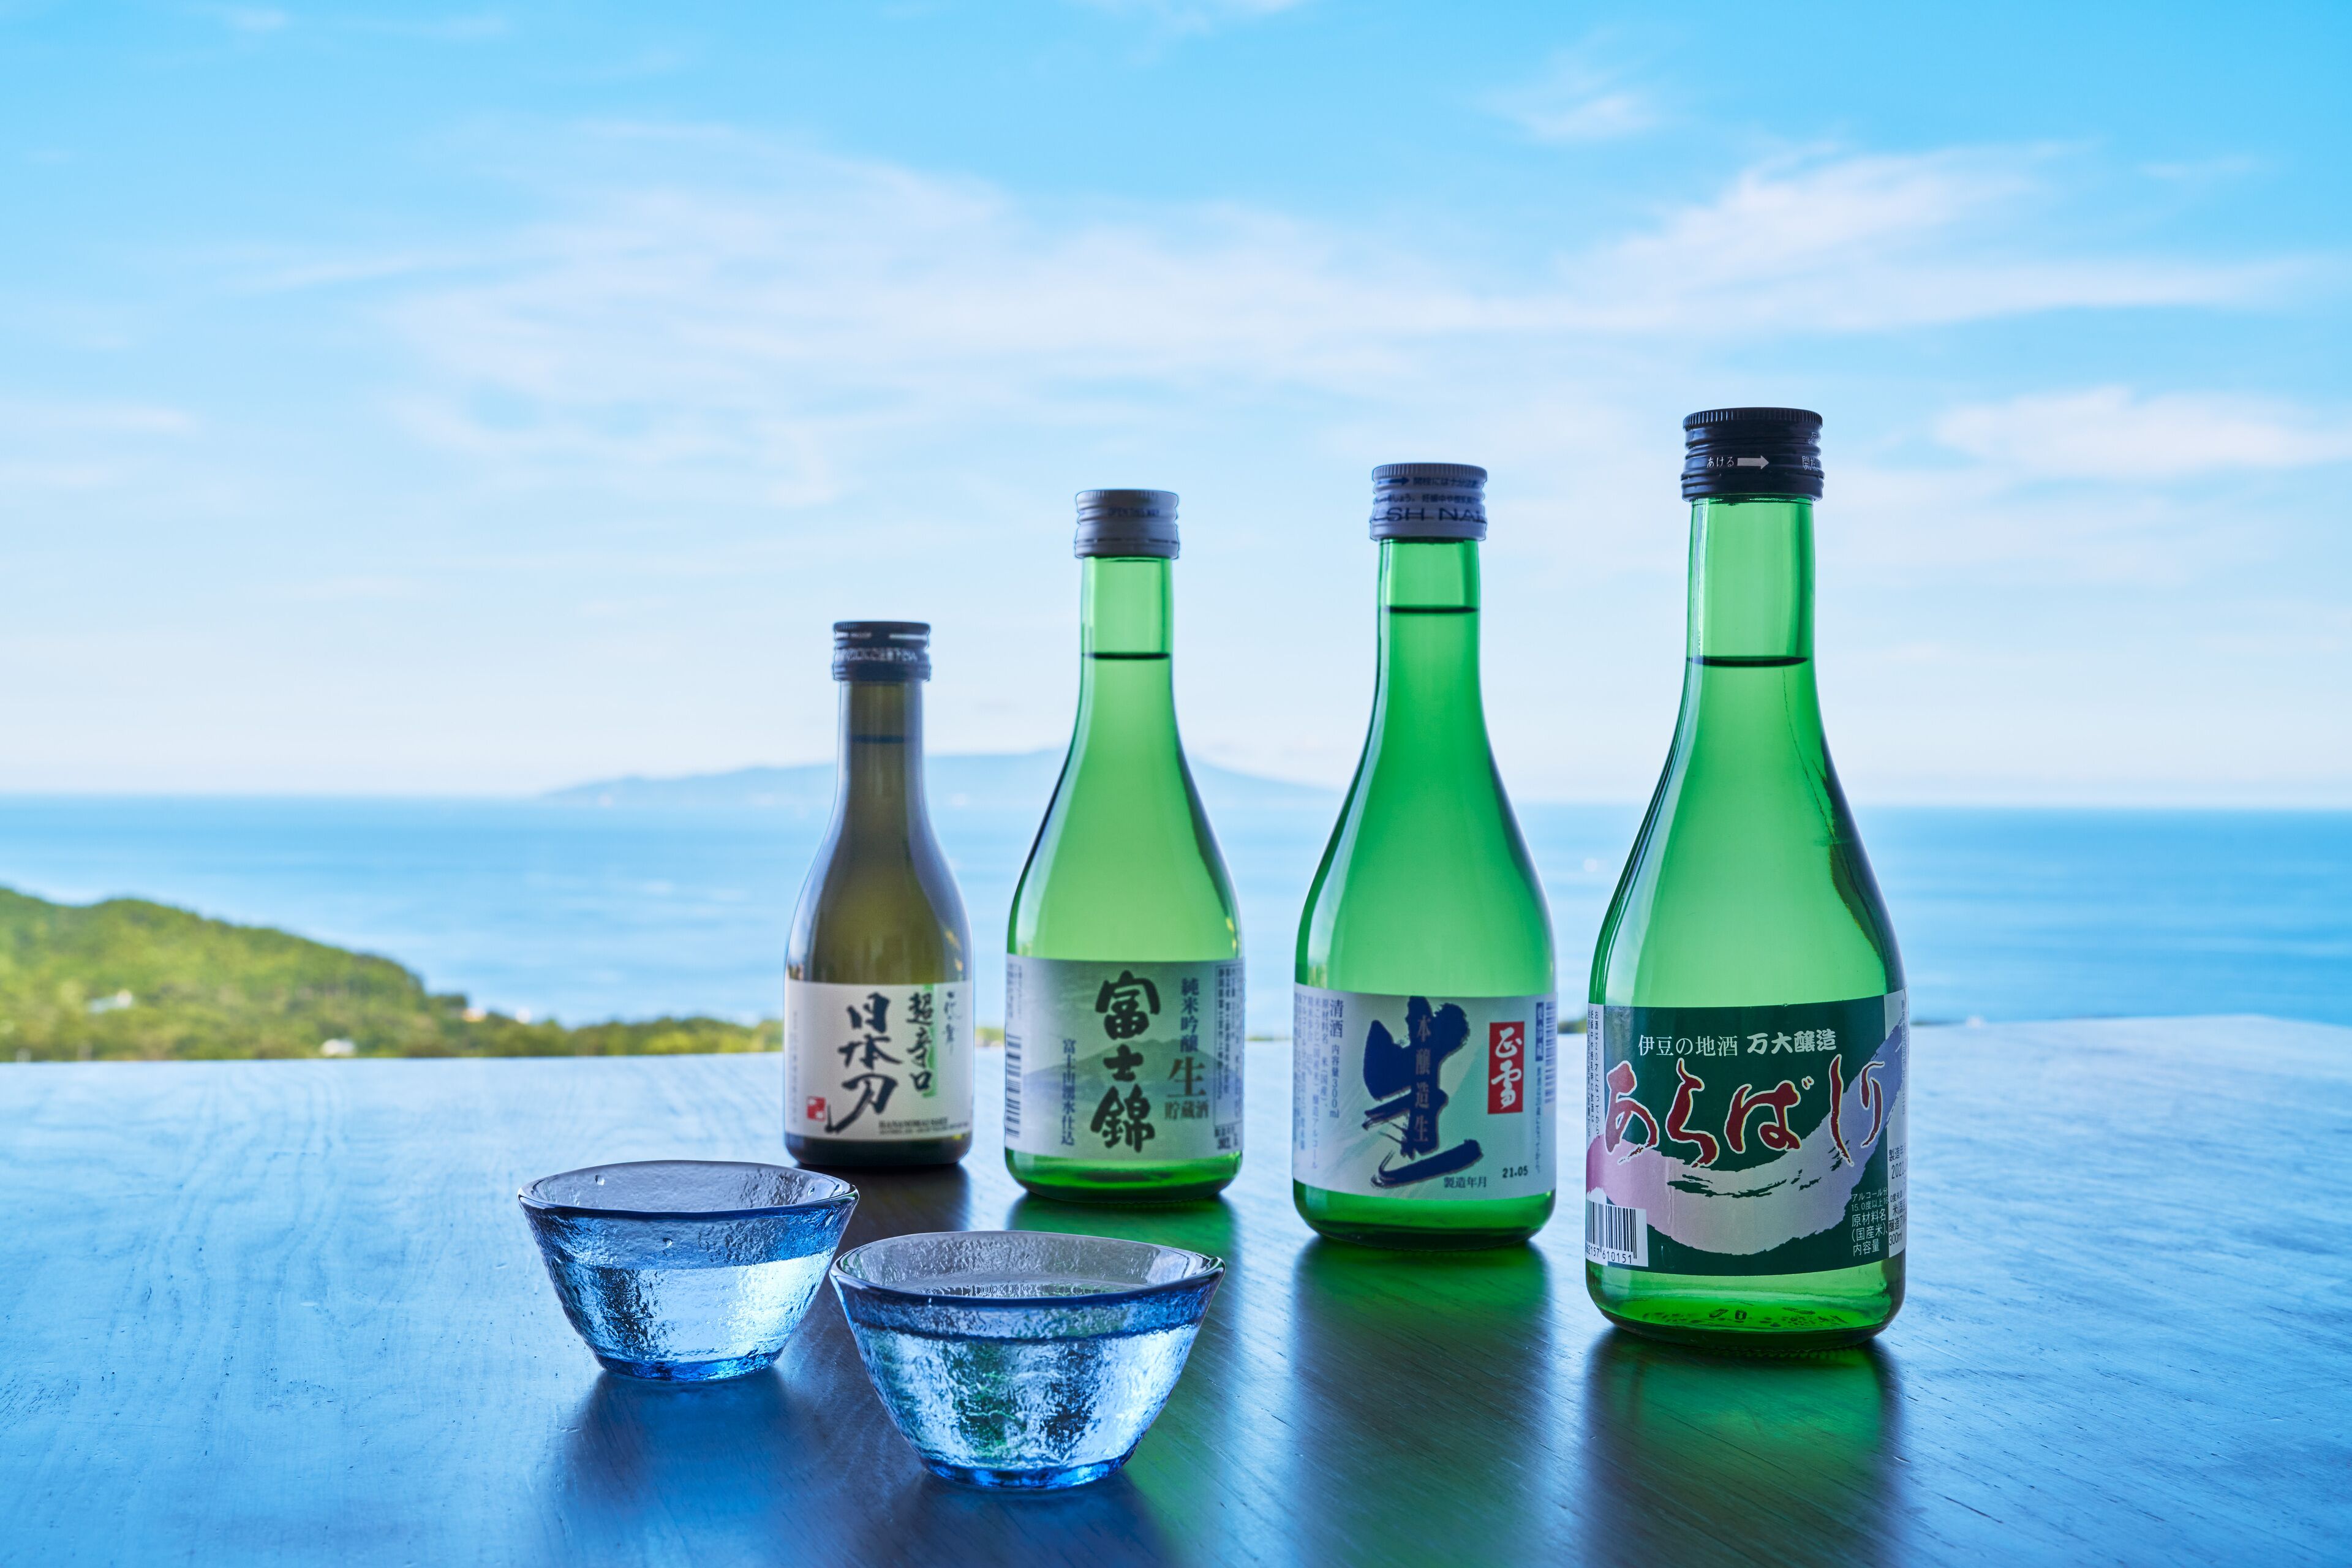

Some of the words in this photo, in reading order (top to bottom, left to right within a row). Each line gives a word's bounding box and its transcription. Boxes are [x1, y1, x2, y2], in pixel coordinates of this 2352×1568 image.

[1706, 456, 1734, 467] あける
[1329, 998, 1344, 1038] 清酒
[906, 991, 933, 1093] 超辛口
[1638, 1034, 1738, 1057] 伊豆の地酒
[824, 991, 903, 1133] 日本刀
[1090, 970, 1161, 1153] 富士錦
[1606, 1054, 1885, 1167] あらばしり
[1502, 1165, 1528, 1178] 21.05
[1444, 1175, 1488, 1189] 製造年月
[1852, 1187, 1888, 1202] アルコール分
[1852, 1208, 1887, 1227] 原材料名
[1602, 1250, 1632, 1264] 610151
[1853, 1238, 1880, 1257] 内容量
